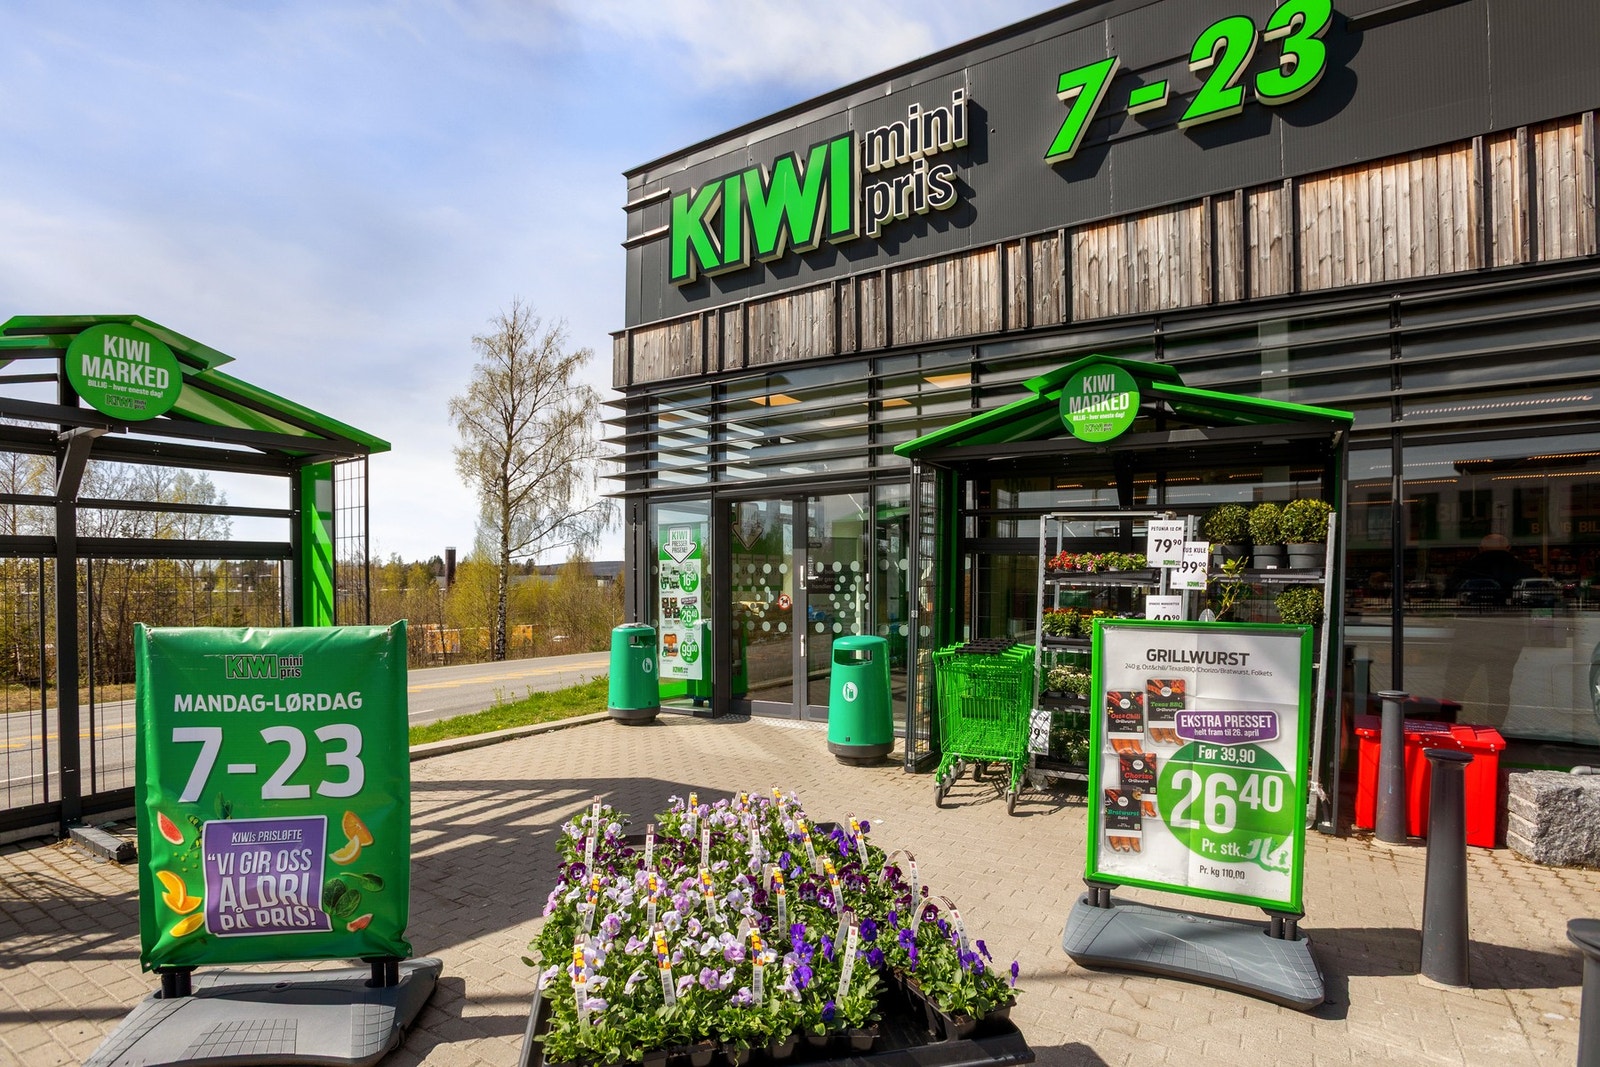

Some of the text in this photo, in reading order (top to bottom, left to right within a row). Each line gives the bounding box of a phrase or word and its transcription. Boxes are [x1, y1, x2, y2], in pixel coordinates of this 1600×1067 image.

[866, 88, 968, 172] mini
[866, 157, 957, 238] pris
[669, 130, 860, 286] KIWI
[104, 334, 150, 363] KIWI
[82, 354, 169, 389] MARKED
[88, 379, 107, 388] BILLIG
[113, 384, 128, 392] hver
[128, 387, 150, 396] eneste
[1083, 374, 1115, 393] KIWI
[105, 394, 134, 408] KIWI
[1069, 392, 1129, 414] MARKED
[672, 530, 688, 540] KIWI
[225, 654, 278, 679] KIWI
[279, 654, 303, 666] mini
[1146, 649, 1250, 666] GRILLWURST
[280, 666, 301, 680] pris
[174, 692, 362, 713] MANDAG-LØRDAG
[1181, 714, 1272, 728] EKSTRA PRESSET
[1244, 729, 1259, 738] april
[172, 724, 364, 802] 7-23
[1199, 745, 1256, 764] Før 39,90
[232, 829, 302, 843] KIWIs PRISLØFTE
[1202, 838, 1217, 853] Pr.
[1220, 840, 1242, 857] stk.
[240, 850, 271, 874] GIR
[276, 849, 312, 871] OSS
[1199, 865, 1245, 880] Pr. kg 110,00
[219, 873, 309, 912] ALDRI
[220, 906, 315, 930] PÅ PRIS!
